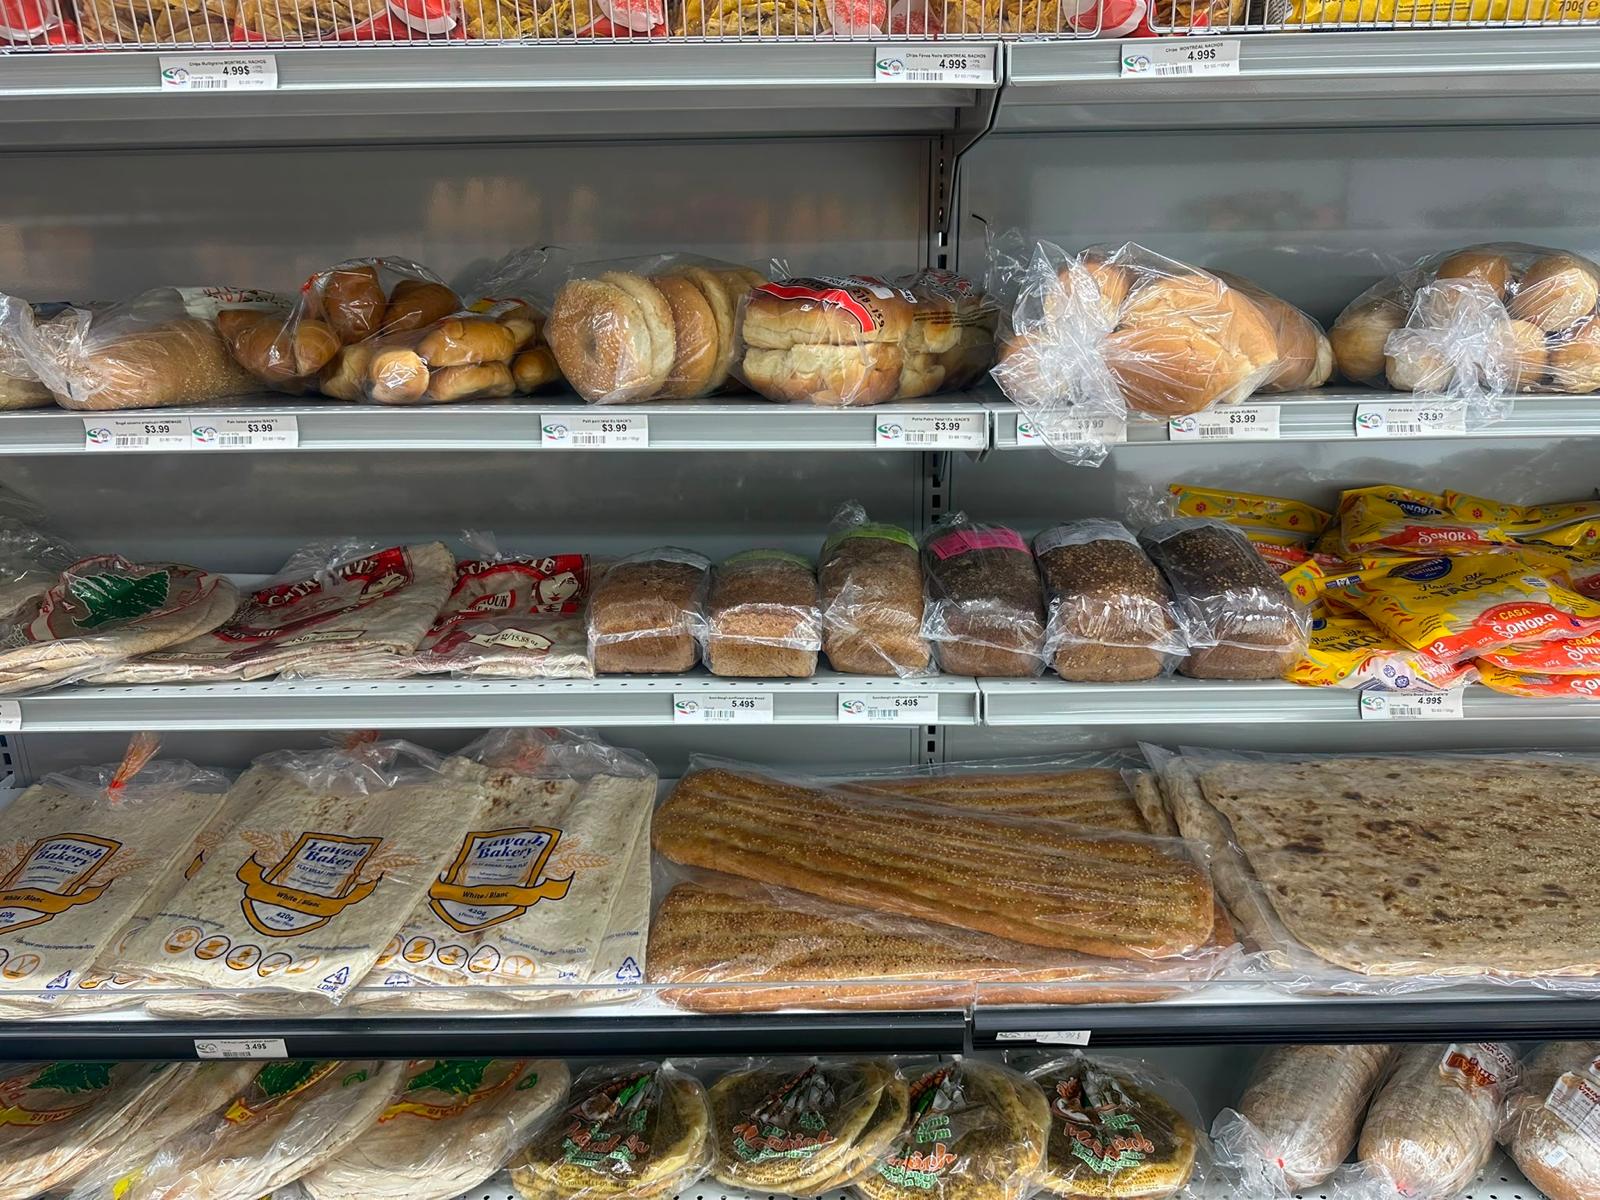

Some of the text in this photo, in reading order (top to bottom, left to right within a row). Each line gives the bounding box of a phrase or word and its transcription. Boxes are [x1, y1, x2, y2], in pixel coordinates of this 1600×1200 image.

[1187, 49, 1216, 60] 4.99$
[939, 59, 967, 69] 4.99$
[222, 65, 250, 76] 4.99$
[1230, 414, 1256, 424] $3.99
[144, 425, 170, 434] $3.99
[247, 424, 273, 433] $3.99
[602, 424, 627, 432] $3.99
[934, 422, 960, 431] $3.99
[1431, 578, 1498, 597] TACO
[1499, 607, 1531, 621] CASA
[1492, 613, 1559, 640] SONORA
[1429, 641, 1447, 656] 12
[732, 700, 755, 708] 5.49$
[895, 699, 918, 707] 5.49$
[1418, 696, 1442, 705] 4.99$
[476, 835, 546, 851] Lawash
[43, 842, 103, 860] Lawash
[477, 846, 534, 860] Bakery
[34, 850, 90, 868] Bakery
[304, 850, 356, 869] Bakery
[277, 891, 297, 903] White
[462, 891, 484, 899] White
[276, 911, 295, 922] 420g
